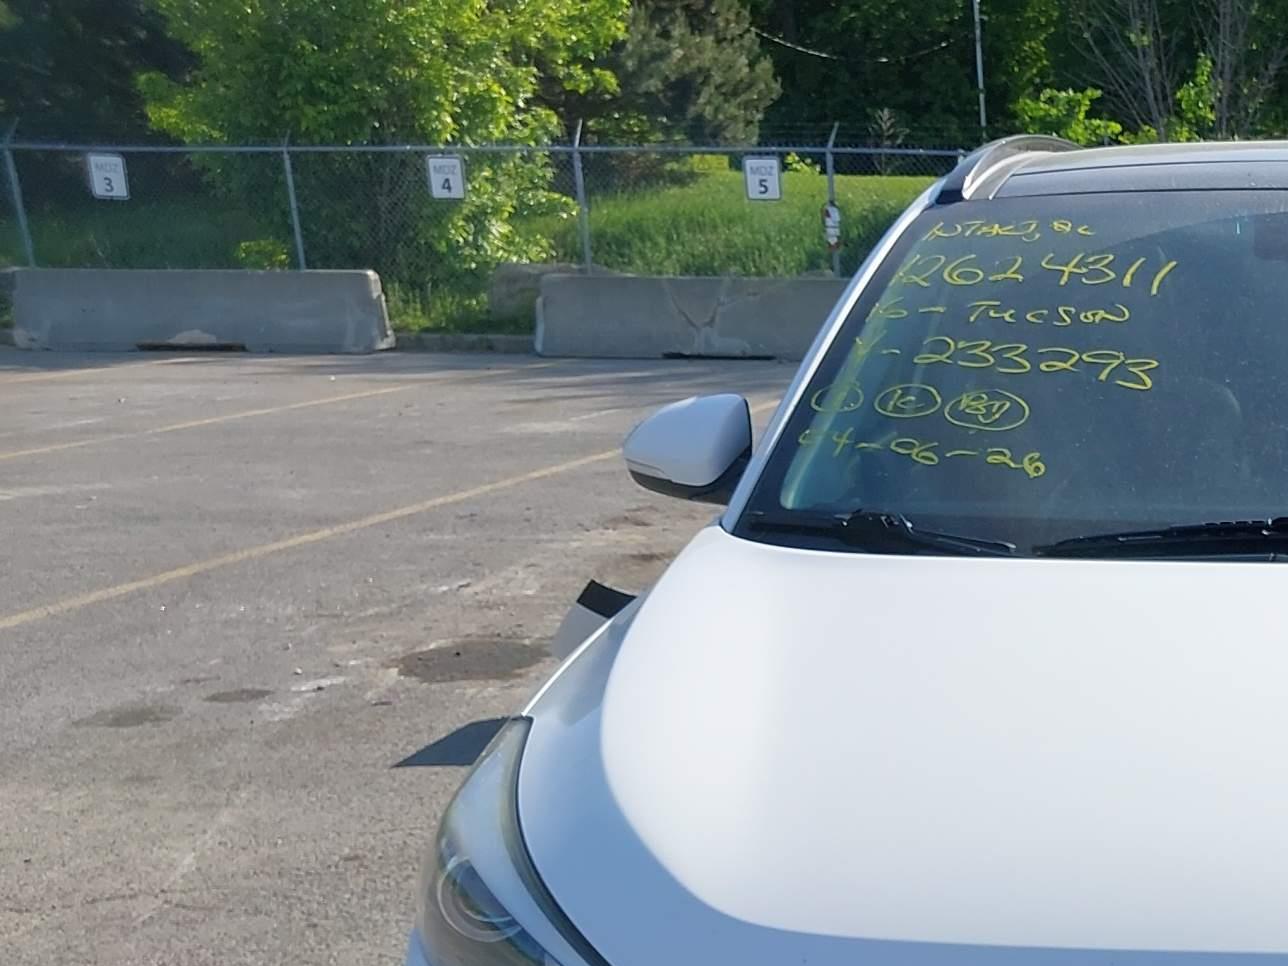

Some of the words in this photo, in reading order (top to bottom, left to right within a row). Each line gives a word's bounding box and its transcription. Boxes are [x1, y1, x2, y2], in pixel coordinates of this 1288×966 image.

[750, 166, 774, 177] MDZ
[103, 177, 115, 193] 3
[441, 178, 452, 193] 4
[758, 179, 769, 194] 5
[888, 253, 1177, 296] 12624311
